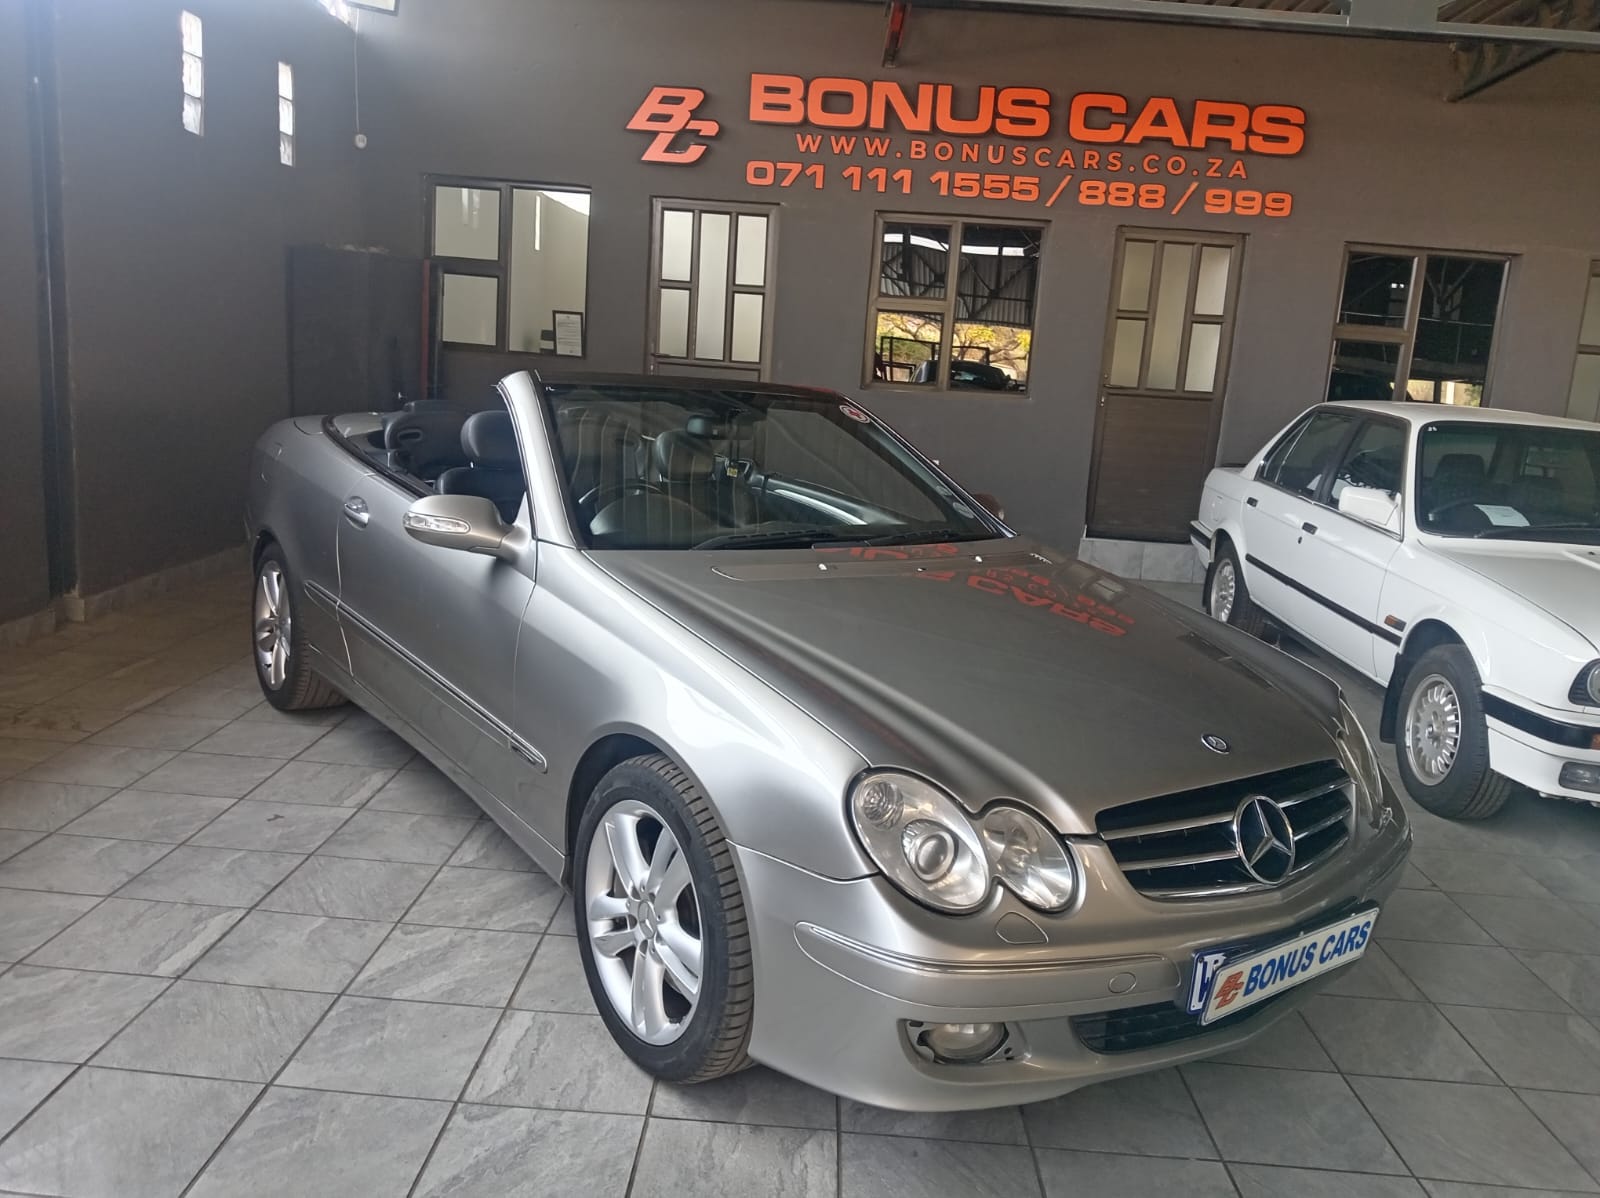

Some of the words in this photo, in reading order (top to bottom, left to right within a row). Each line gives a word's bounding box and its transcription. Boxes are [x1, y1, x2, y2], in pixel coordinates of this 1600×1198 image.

[749, 73, 1051, 137] BONUS
[1068, 92, 1306, 156] CARS
[745, 160, 825, 190] 071
[842, 165, 913, 195] 111
[796, 133, 1248, 179] WWW.BONUSCARS.CO.ZA
[1243, 941, 1318, 997] BONUS
[1318, 920, 1372, 965] CARS
